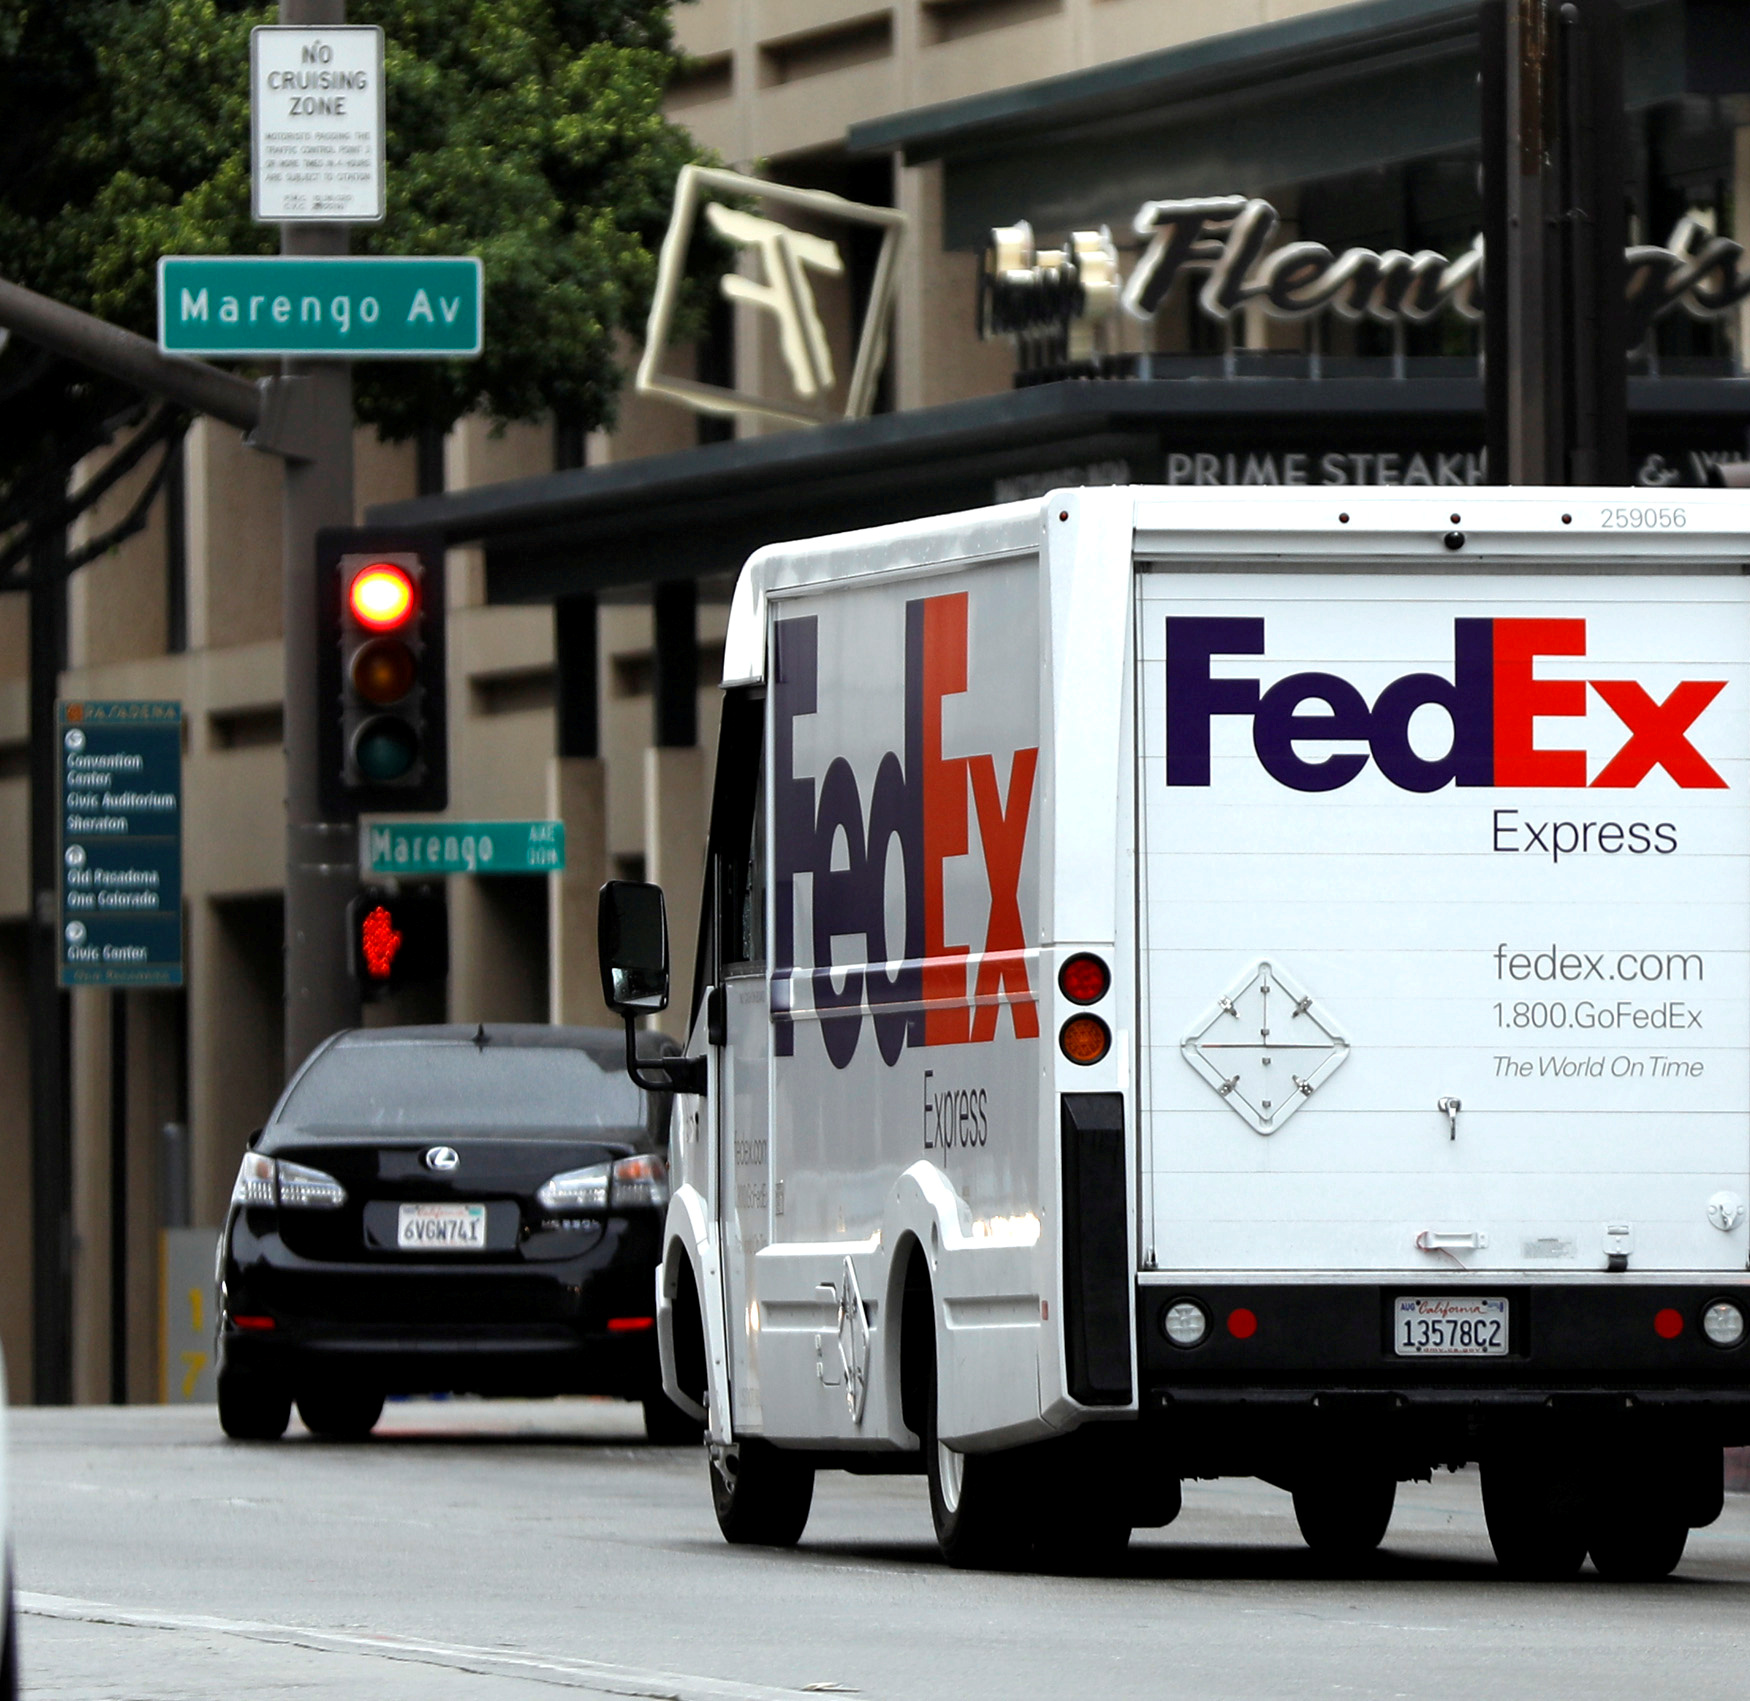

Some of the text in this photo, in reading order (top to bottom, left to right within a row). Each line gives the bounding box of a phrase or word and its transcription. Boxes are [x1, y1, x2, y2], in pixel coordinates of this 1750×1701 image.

[302, 45, 332, 63] NO
[268, 71, 367, 90] CRUISING
[290, 97, 346, 116] ZONE
[180, 287, 460, 333] Marengo Av
[1168, 453, 1307, 485] PRIME
[1601, 508, 1687, 528] 259056
[1165, 616, 1731, 793] FedEx
[774, 591, 1040, 1069] FedEx
[1493, 809, 1678, 863] Express
[372, 828, 493, 871] Marengo
[1493, 943, 1704, 981] fedex.com
[1493, 1001, 1703, 1029] 1.800.GoFedEx
[1493, 1056, 1704, 1077] The World On Time
[924, 1069, 988, 1169] Express
[1419, 1300, 1486, 1318] California
[1403, 1319, 1502, 1347] 13578C2
